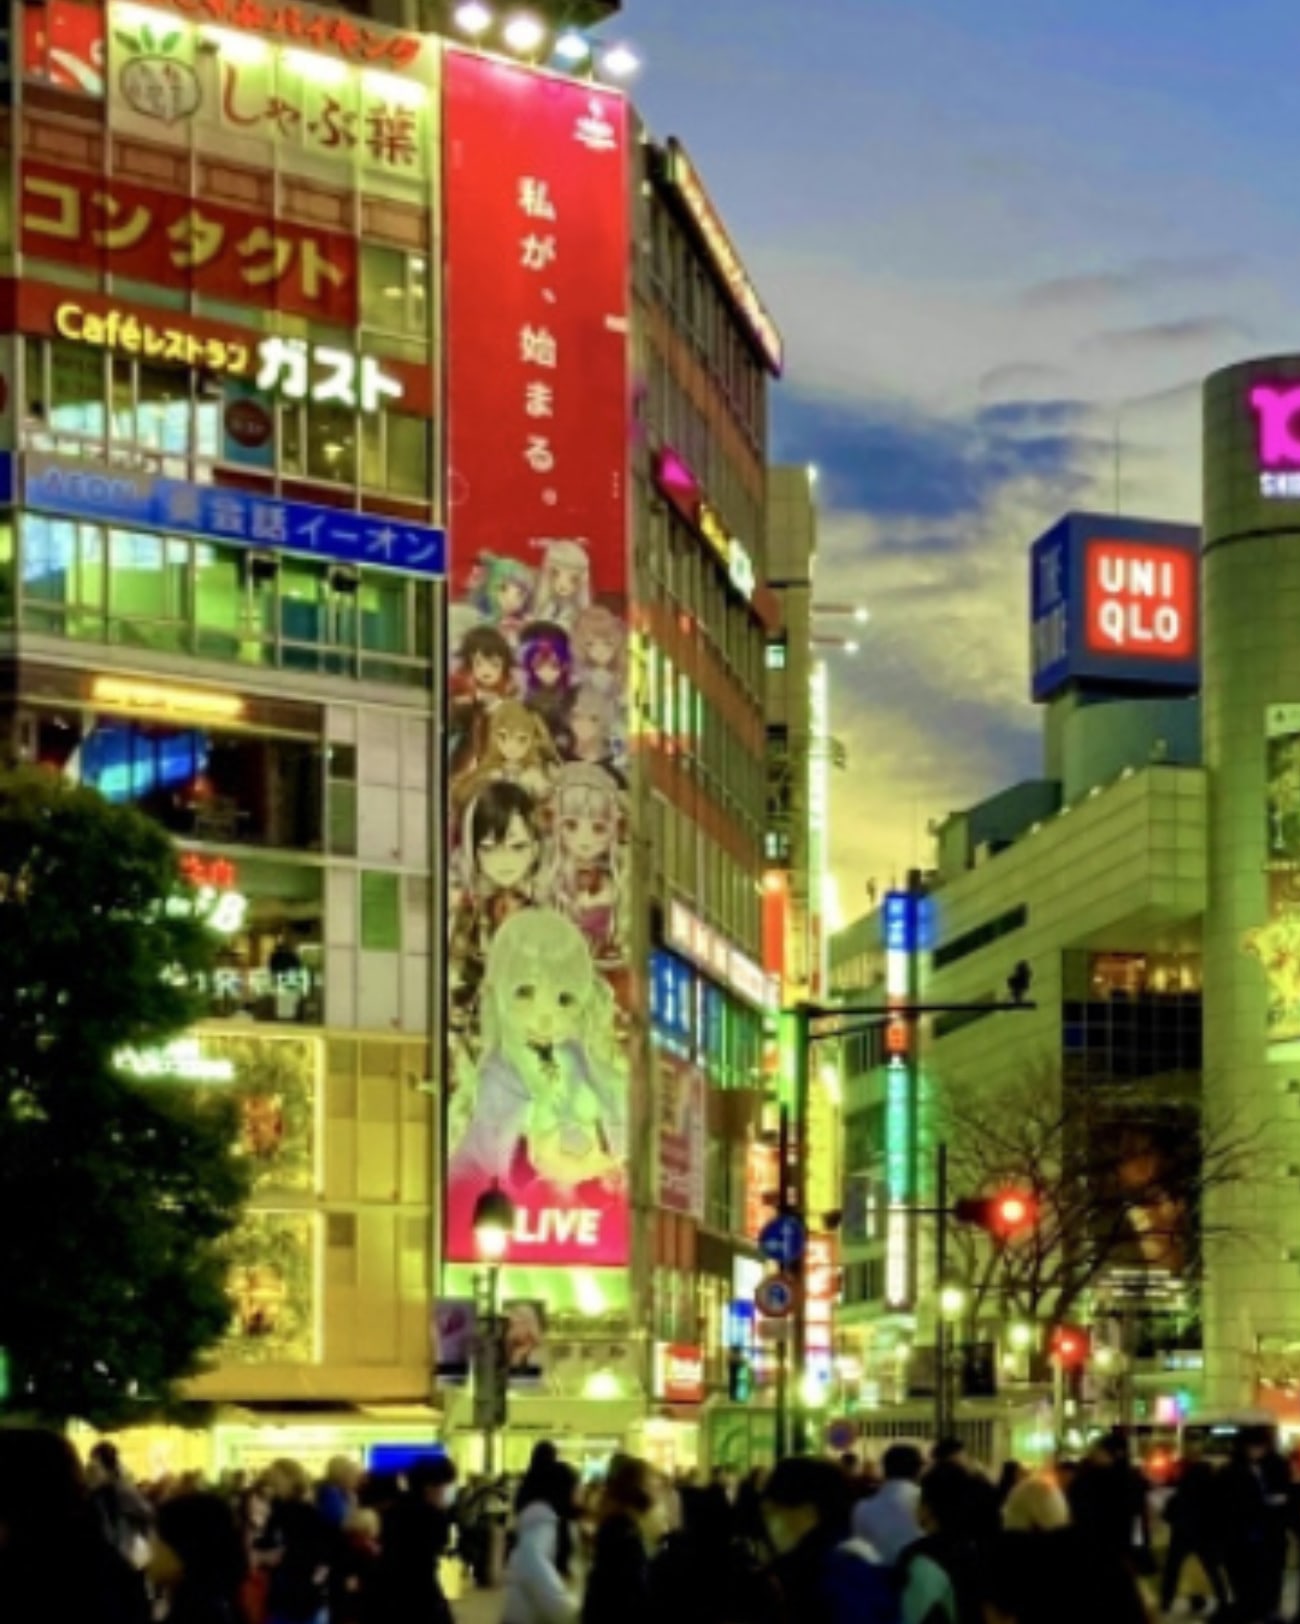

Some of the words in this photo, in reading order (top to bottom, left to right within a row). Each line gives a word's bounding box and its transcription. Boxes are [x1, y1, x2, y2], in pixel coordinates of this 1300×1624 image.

[222, 65, 419, 167] しゃぶ葉
[23, 176, 345, 298] コンタクト
[256, 336, 405, 412] ガスト
[1099, 555, 1174, 598] UNI
[1099, 602, 1179, 645] QLO
[514, 1207, 602, 1246] LIVE
